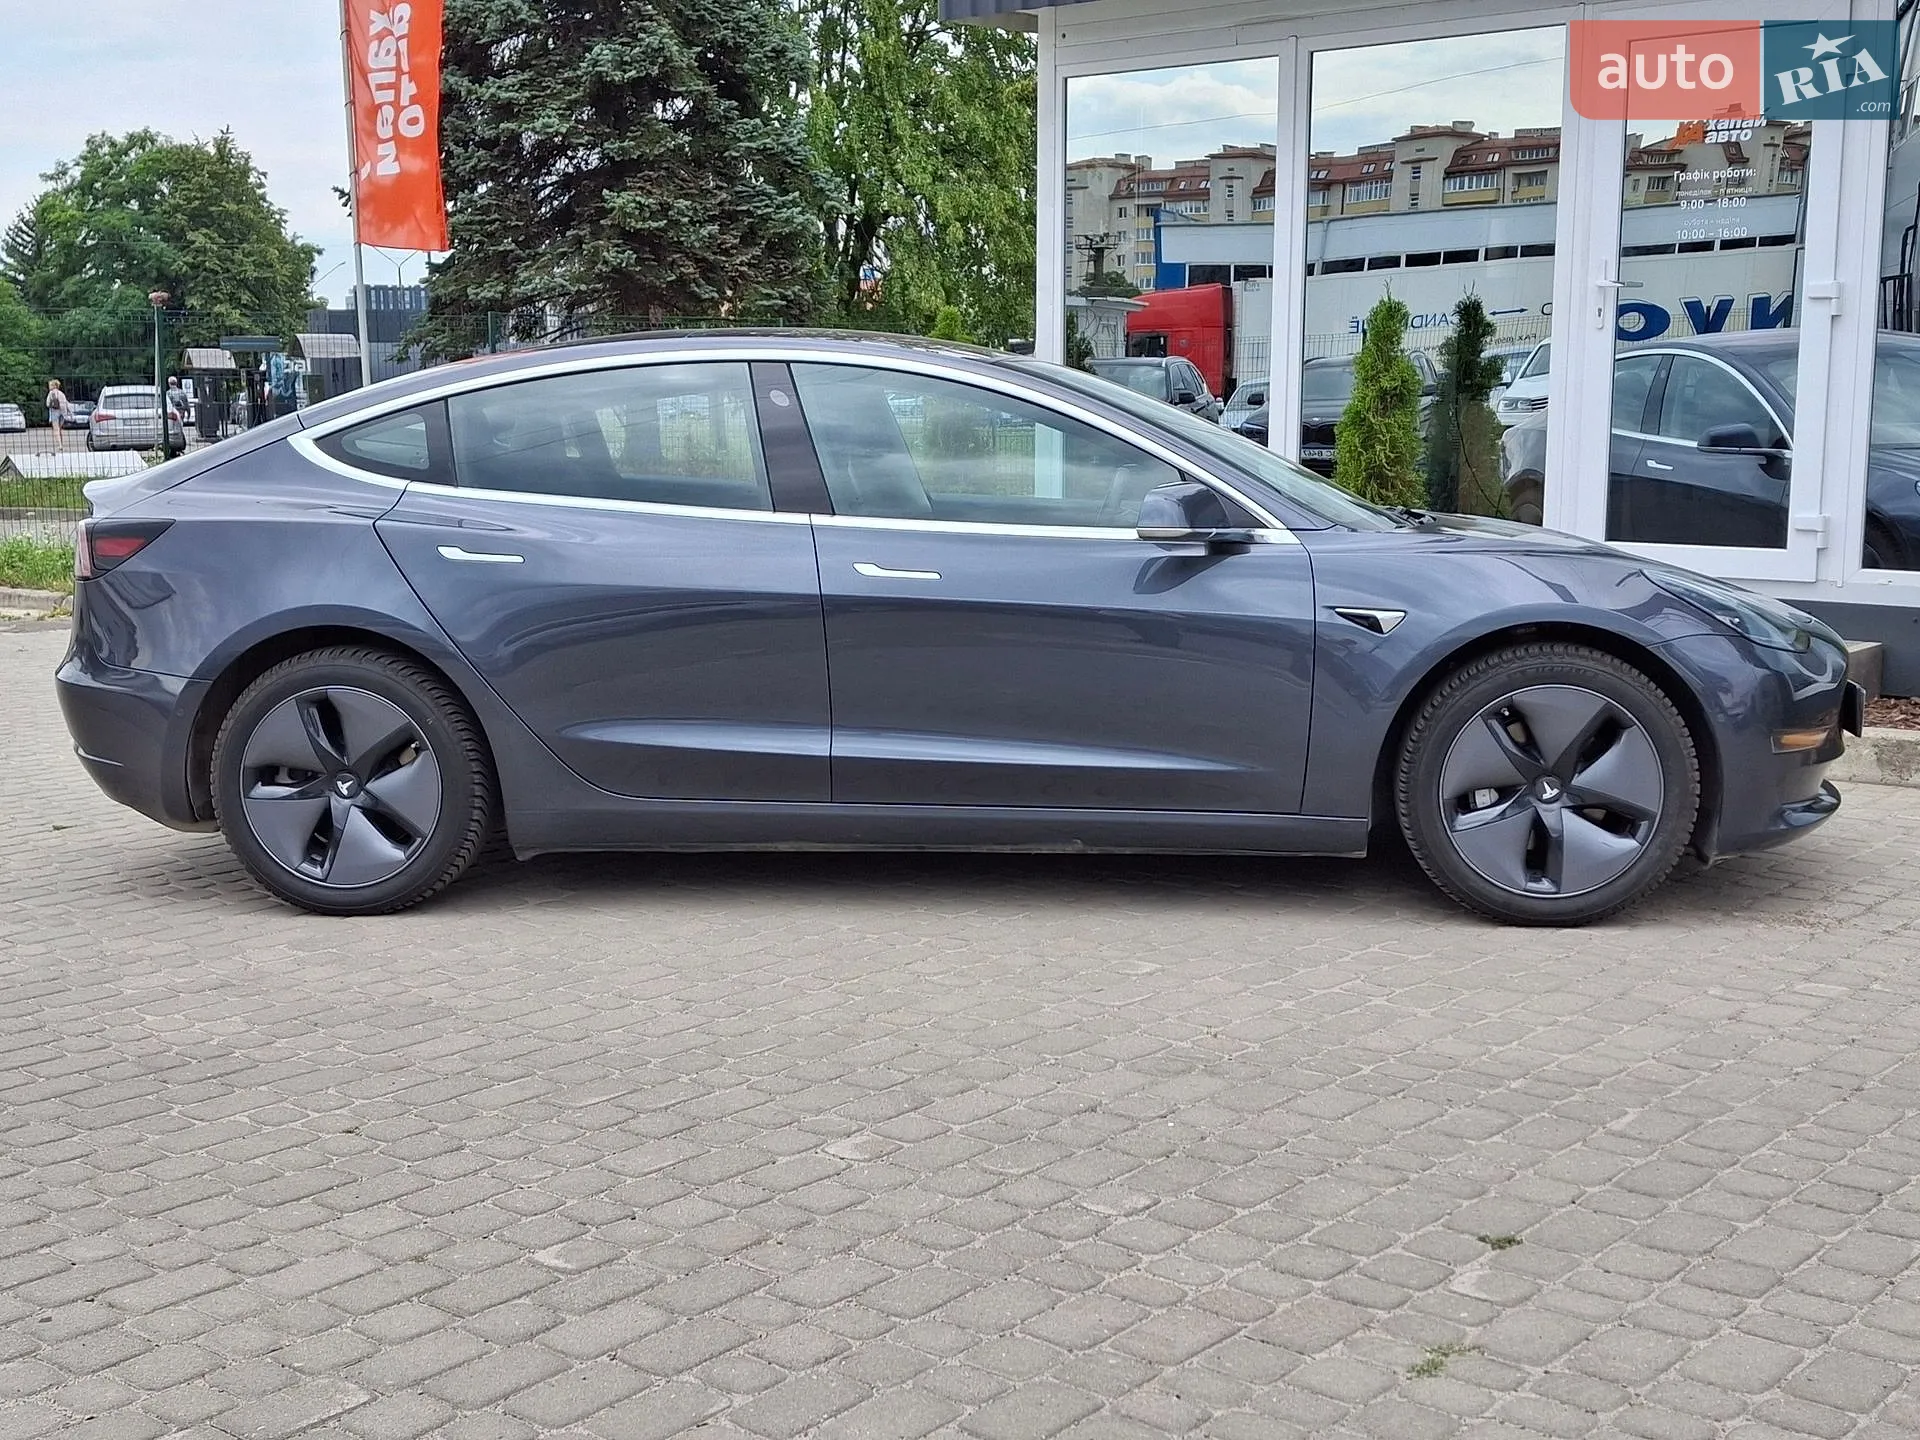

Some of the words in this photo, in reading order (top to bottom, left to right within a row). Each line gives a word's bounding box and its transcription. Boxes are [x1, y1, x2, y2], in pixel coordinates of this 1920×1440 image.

[1705, 129, 1752, 144] авто
[1673, 168, 1710, 183] Графік
[1713, 167, 1757, 181] роботи:
[1680, 199, 1704, 210] 9:00
[1717, 197, 1747, 208] 18:00
[1676, 229, 1706, 240] 10:00
[1719, 227, 1748, 238] 16:00
